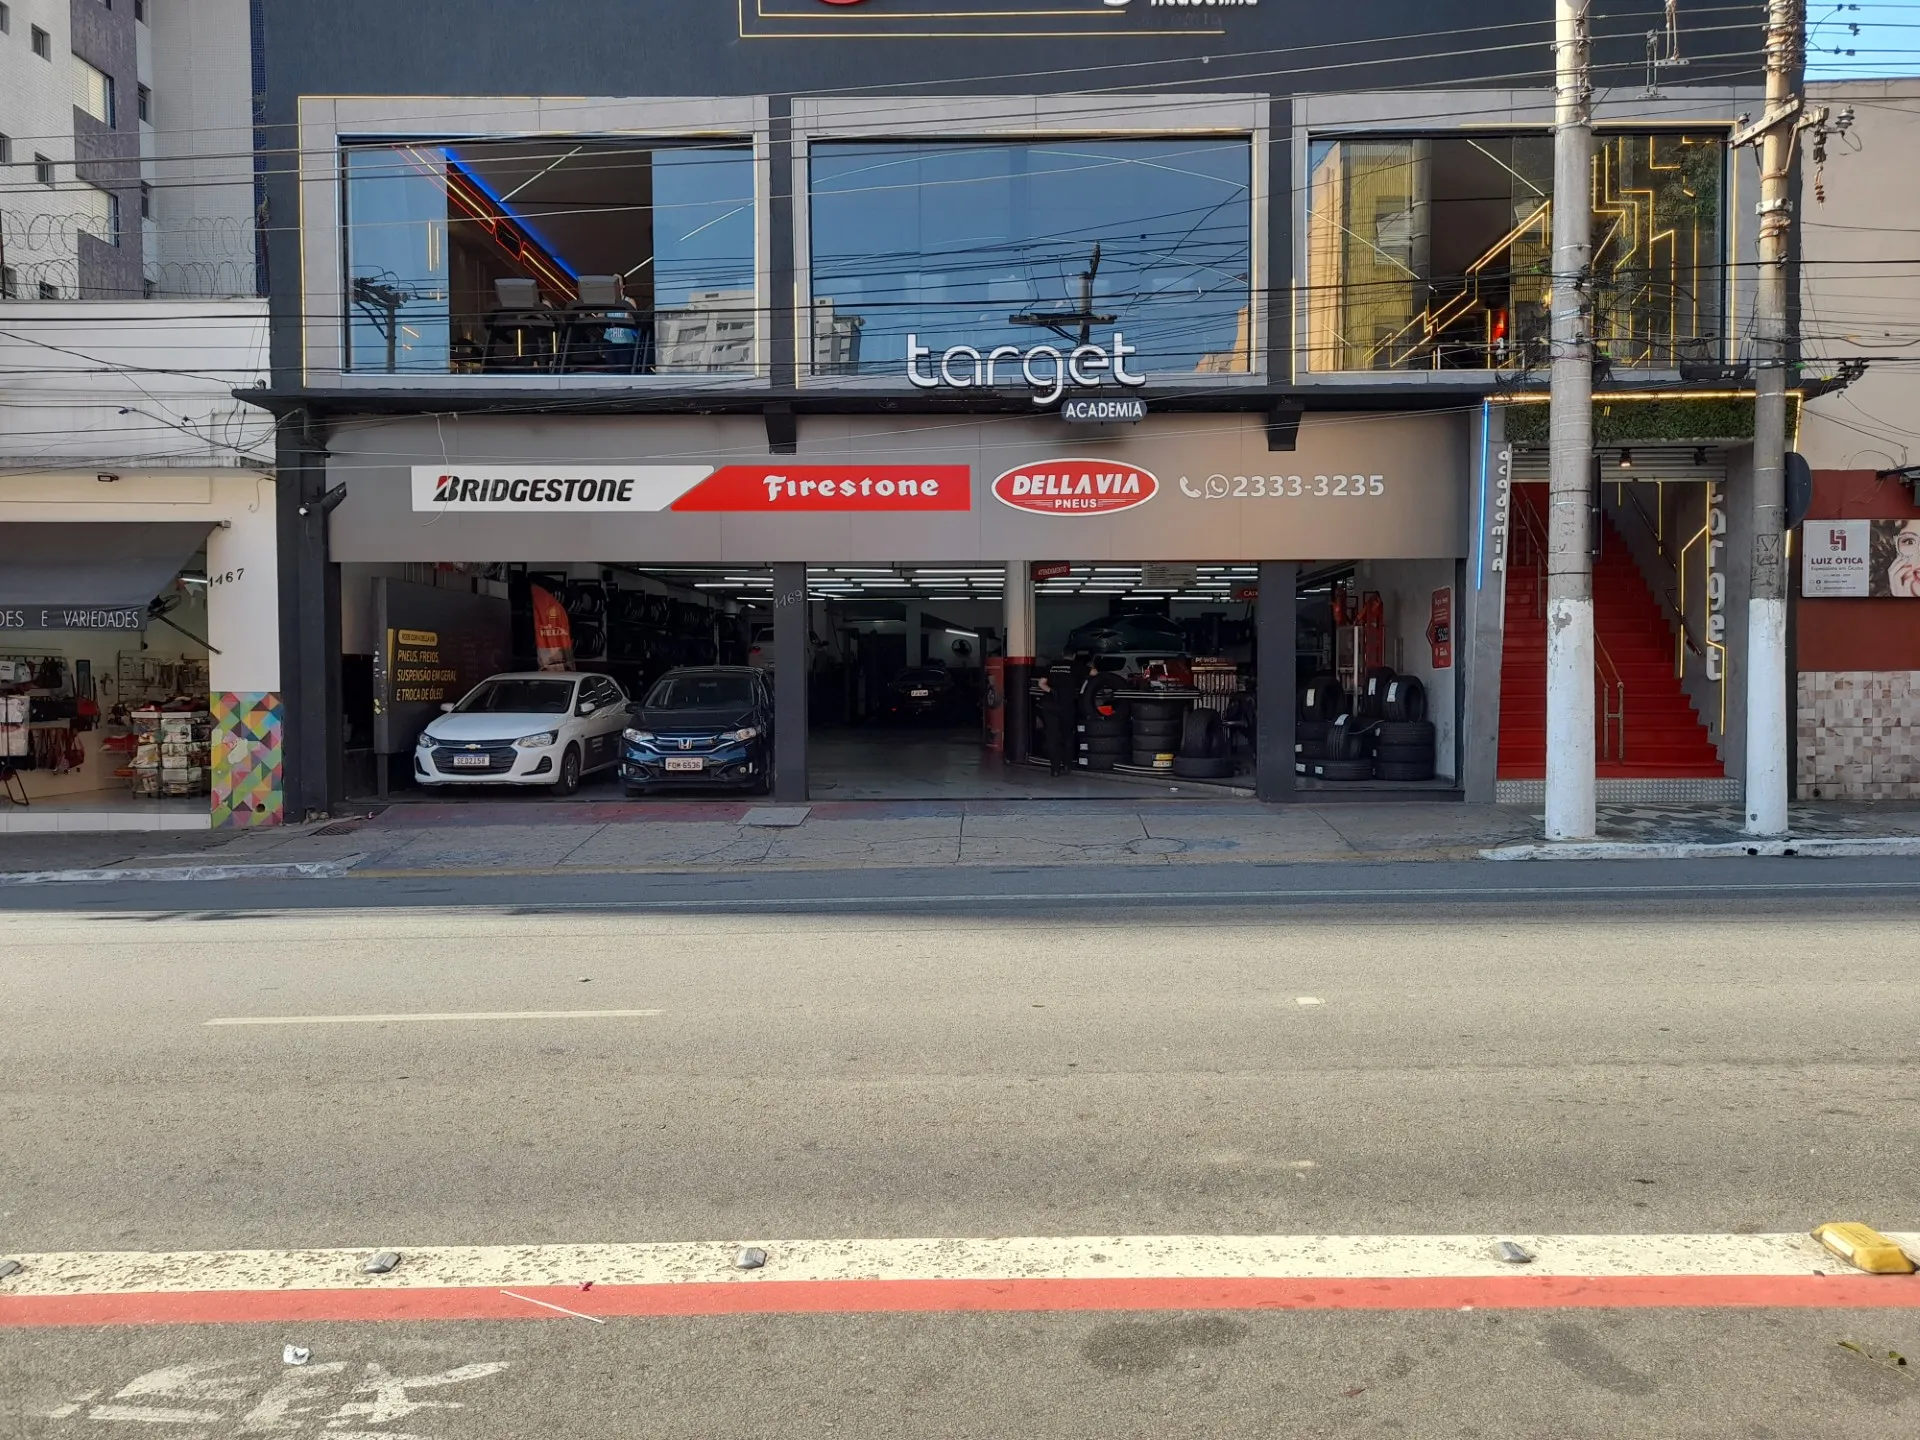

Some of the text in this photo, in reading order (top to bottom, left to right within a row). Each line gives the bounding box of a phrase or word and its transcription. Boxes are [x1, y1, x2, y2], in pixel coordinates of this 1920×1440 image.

[906, 332, 1147, 405] target
[1065, 402, 1143, 418] ACADEMIA
[433, 475, 635, 502] BRIDGESTONE
[762, 475, 939, 502] Firestone
[1233, 475, 1384, 497] 2333-3235
[1055, 499, 1097, 508] PNEUS
[41, 610, 48, 627] E
[63, 610, 139, 628] VARIEDADES
[397, 666, 456, 682] SUSPENSÃO EM GERAL
[396, 685, 444, 701] E TROCA DE ÓLEO
